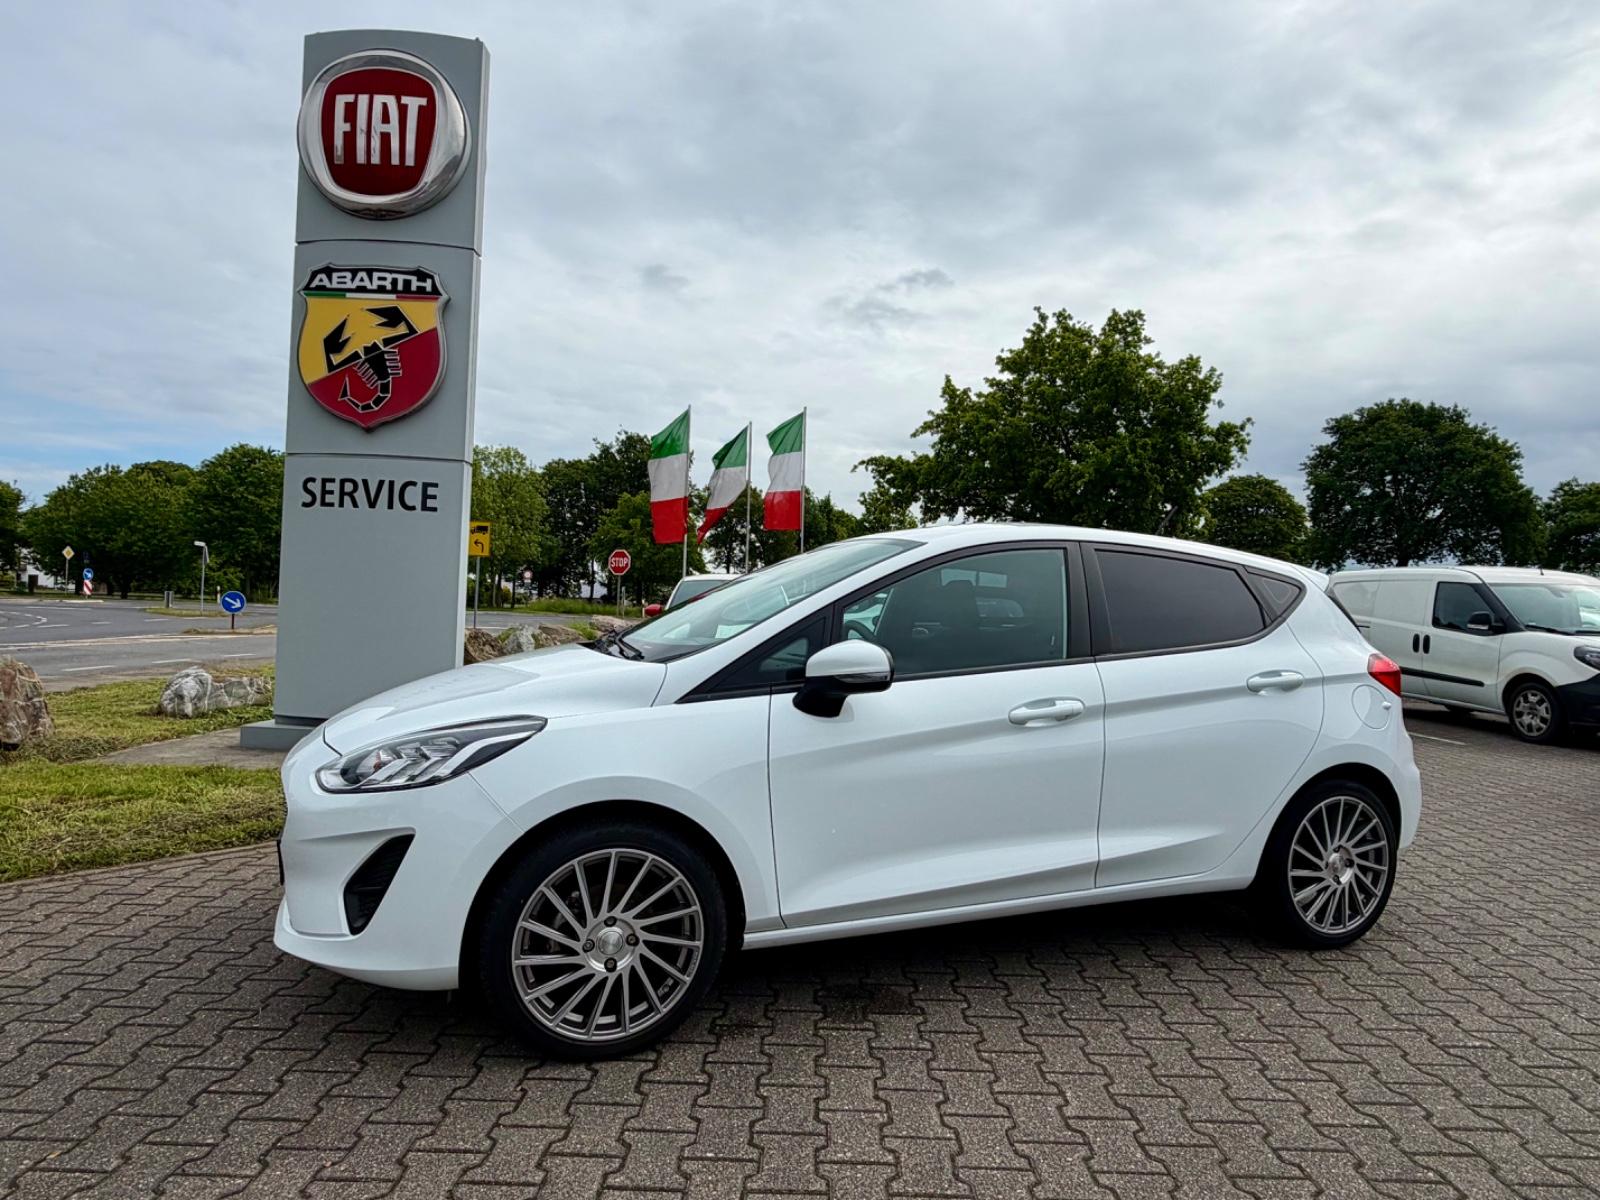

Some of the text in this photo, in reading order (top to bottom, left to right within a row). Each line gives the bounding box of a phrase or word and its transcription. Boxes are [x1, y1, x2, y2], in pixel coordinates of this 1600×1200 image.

[334, 94, 427, 166] FIAT
[309, 271, 433, 292] ABARTH
[301, 477, 439, 512] SERVICE
[611, 557, 628, 567] STOP
